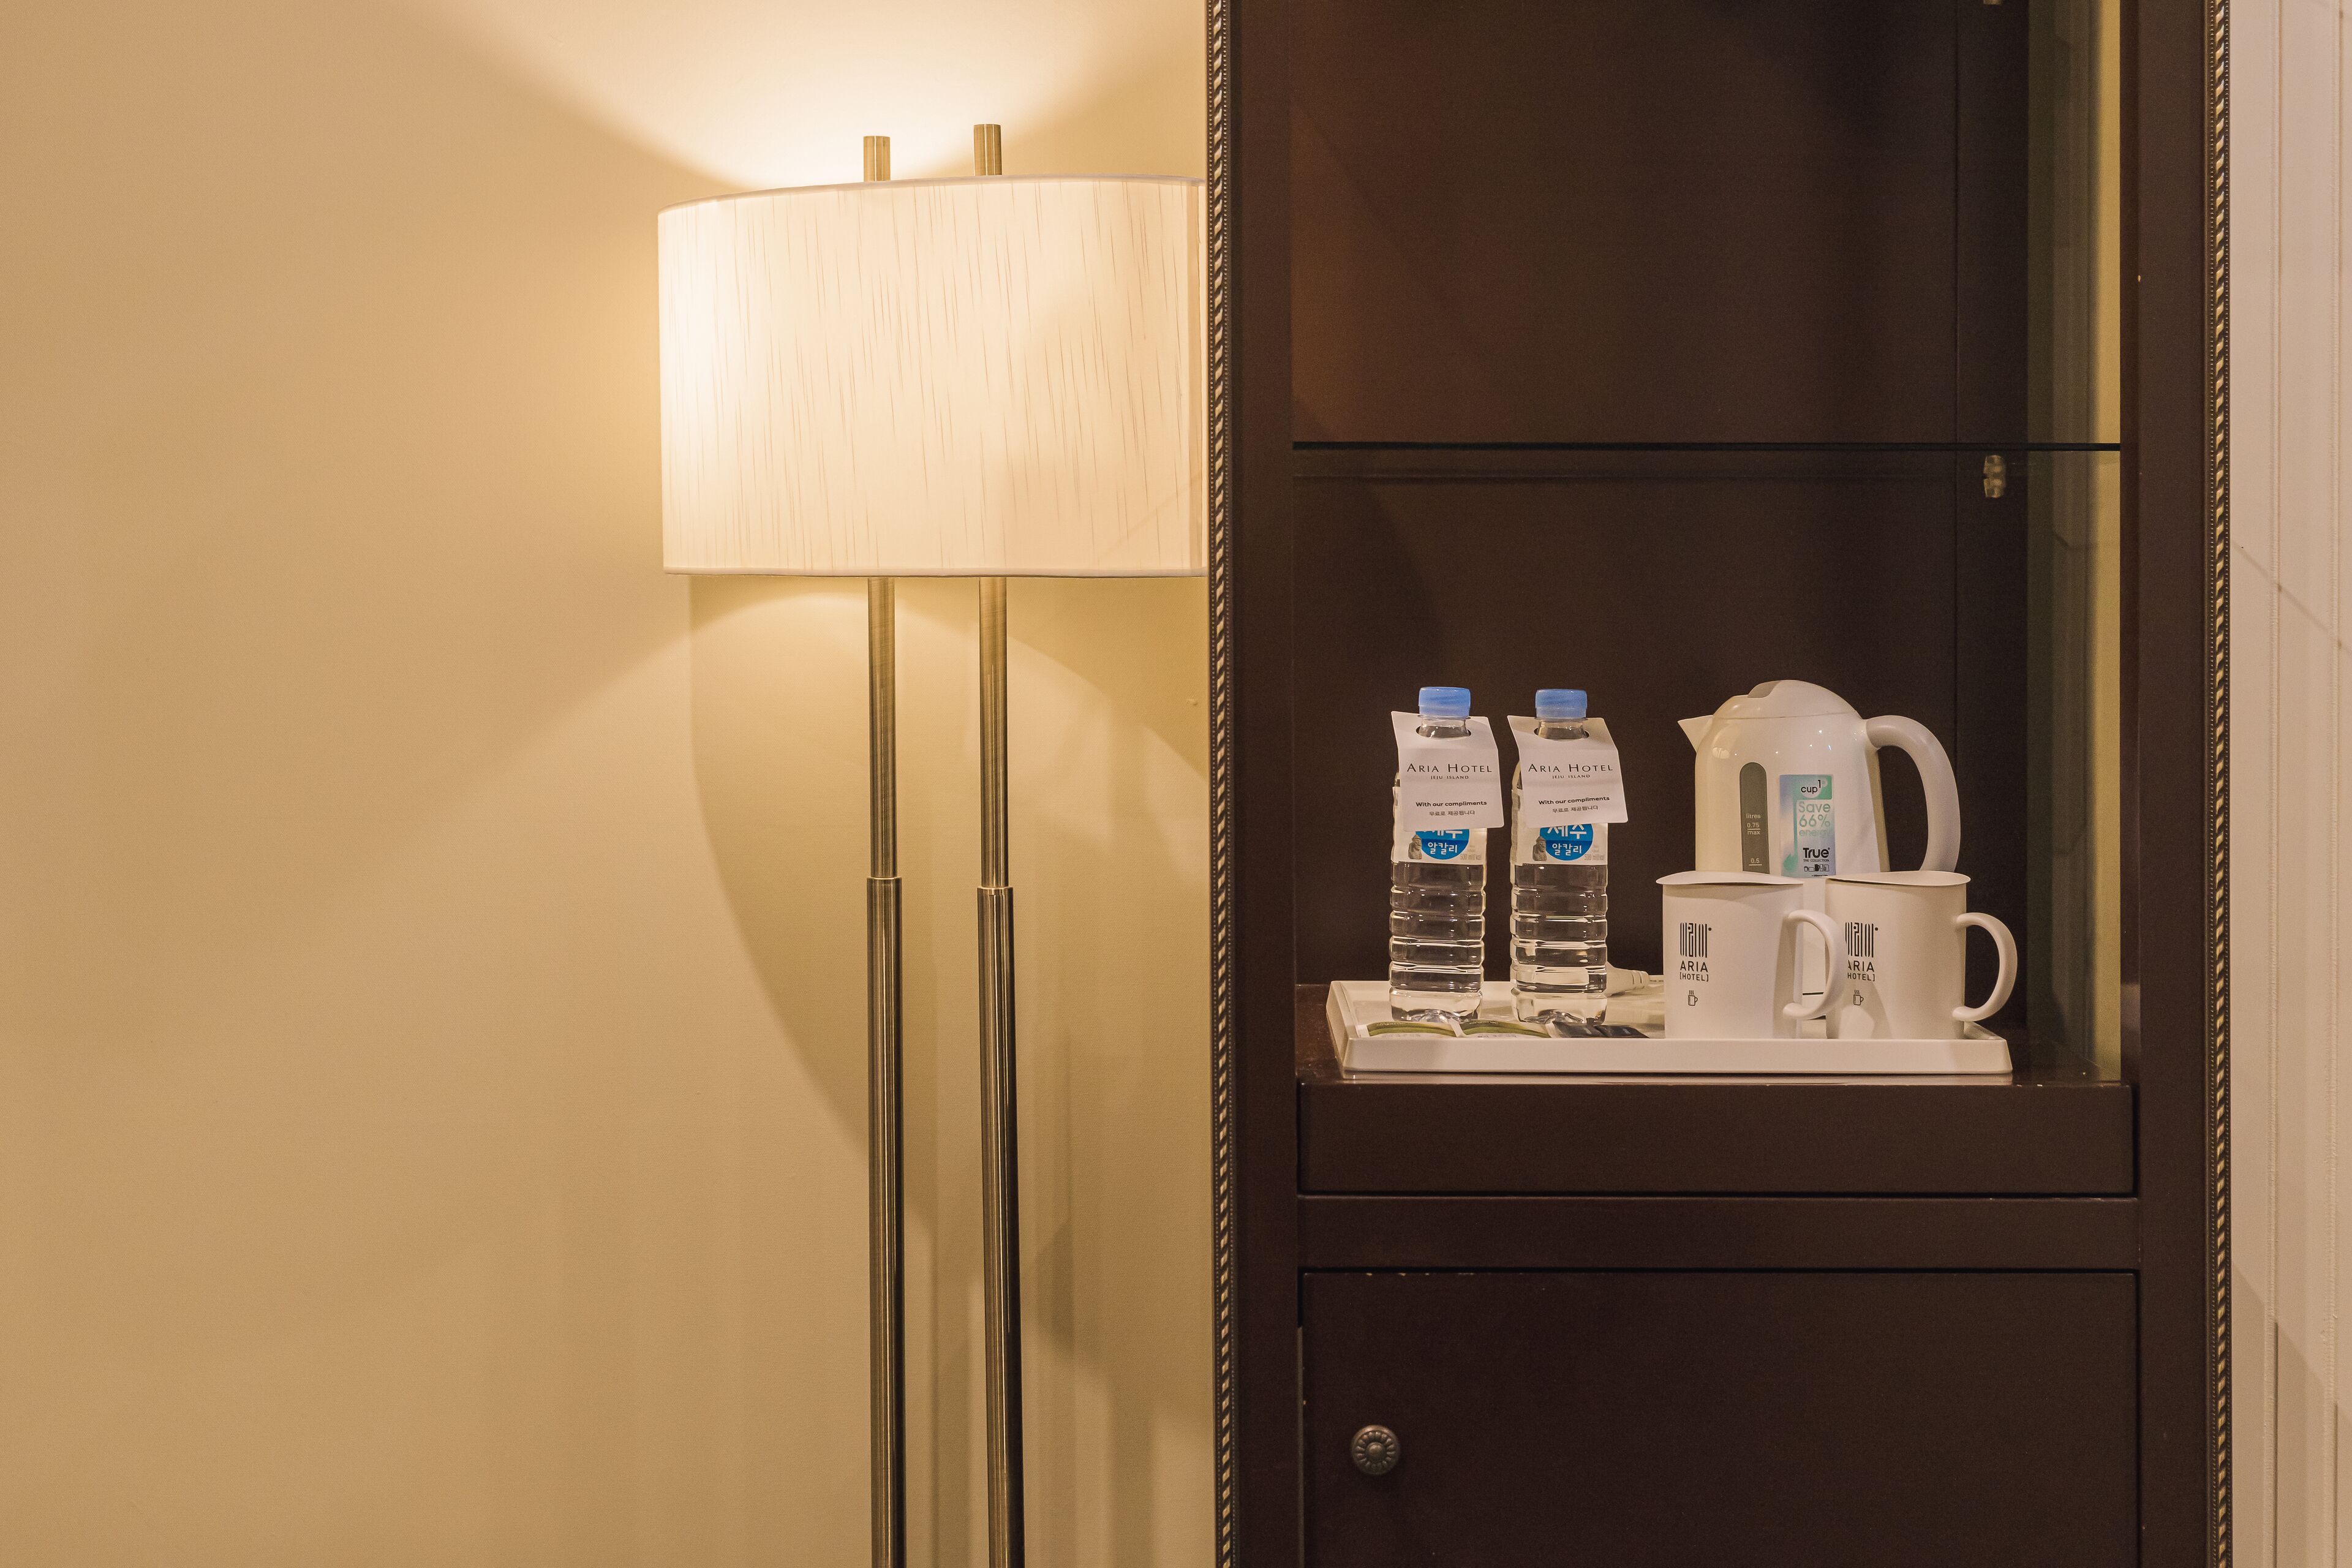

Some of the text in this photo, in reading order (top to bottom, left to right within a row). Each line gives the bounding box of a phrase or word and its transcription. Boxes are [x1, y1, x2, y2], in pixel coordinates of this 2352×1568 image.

[1798, 801, 1831, 813] Save
[1798, 814, 1831, 827] 66%
[1799, 829, 1833, 839] energ
[1428, 842, 1458, 855] 알칼리
[1552, 843, 1581, 856] 알칼리
[1680, 960, 1708, 972] ARIA
